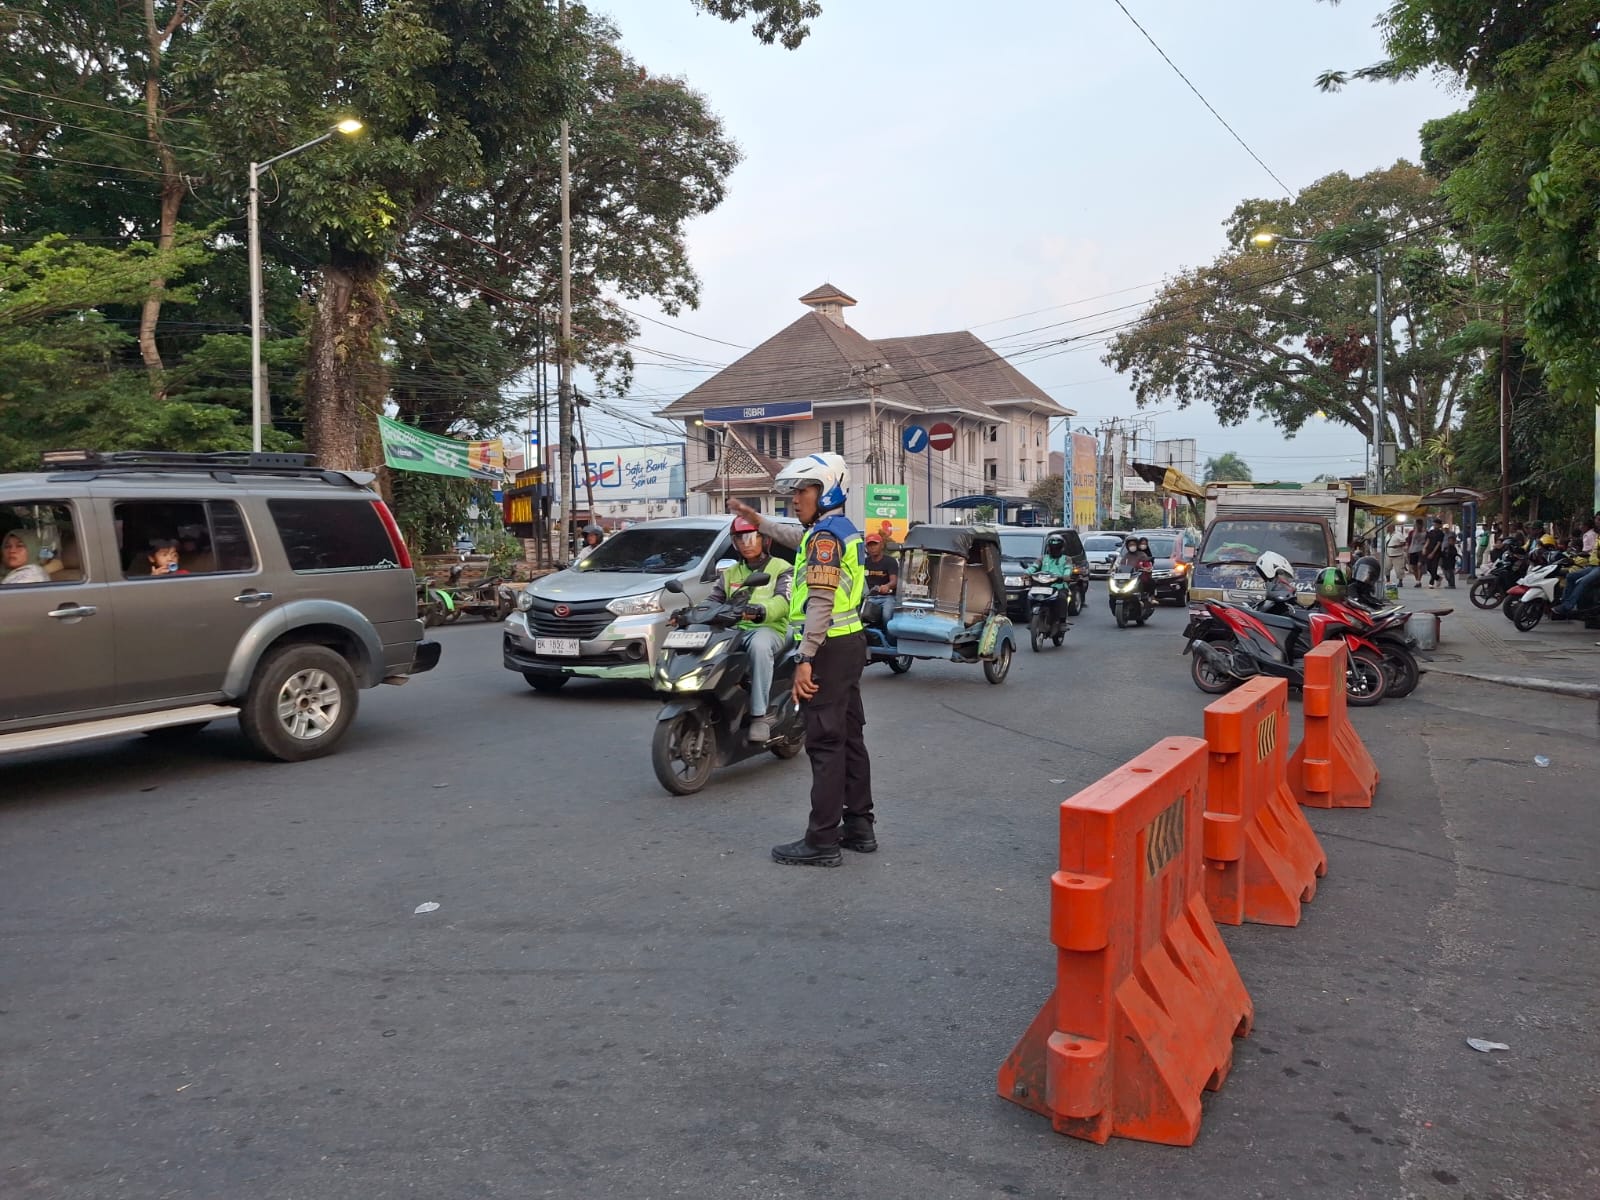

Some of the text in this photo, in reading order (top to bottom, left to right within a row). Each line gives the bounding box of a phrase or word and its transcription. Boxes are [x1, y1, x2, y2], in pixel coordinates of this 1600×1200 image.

[625, 456, 668, 477] Satu Bank
[631, 475, 657, 490] Semua
